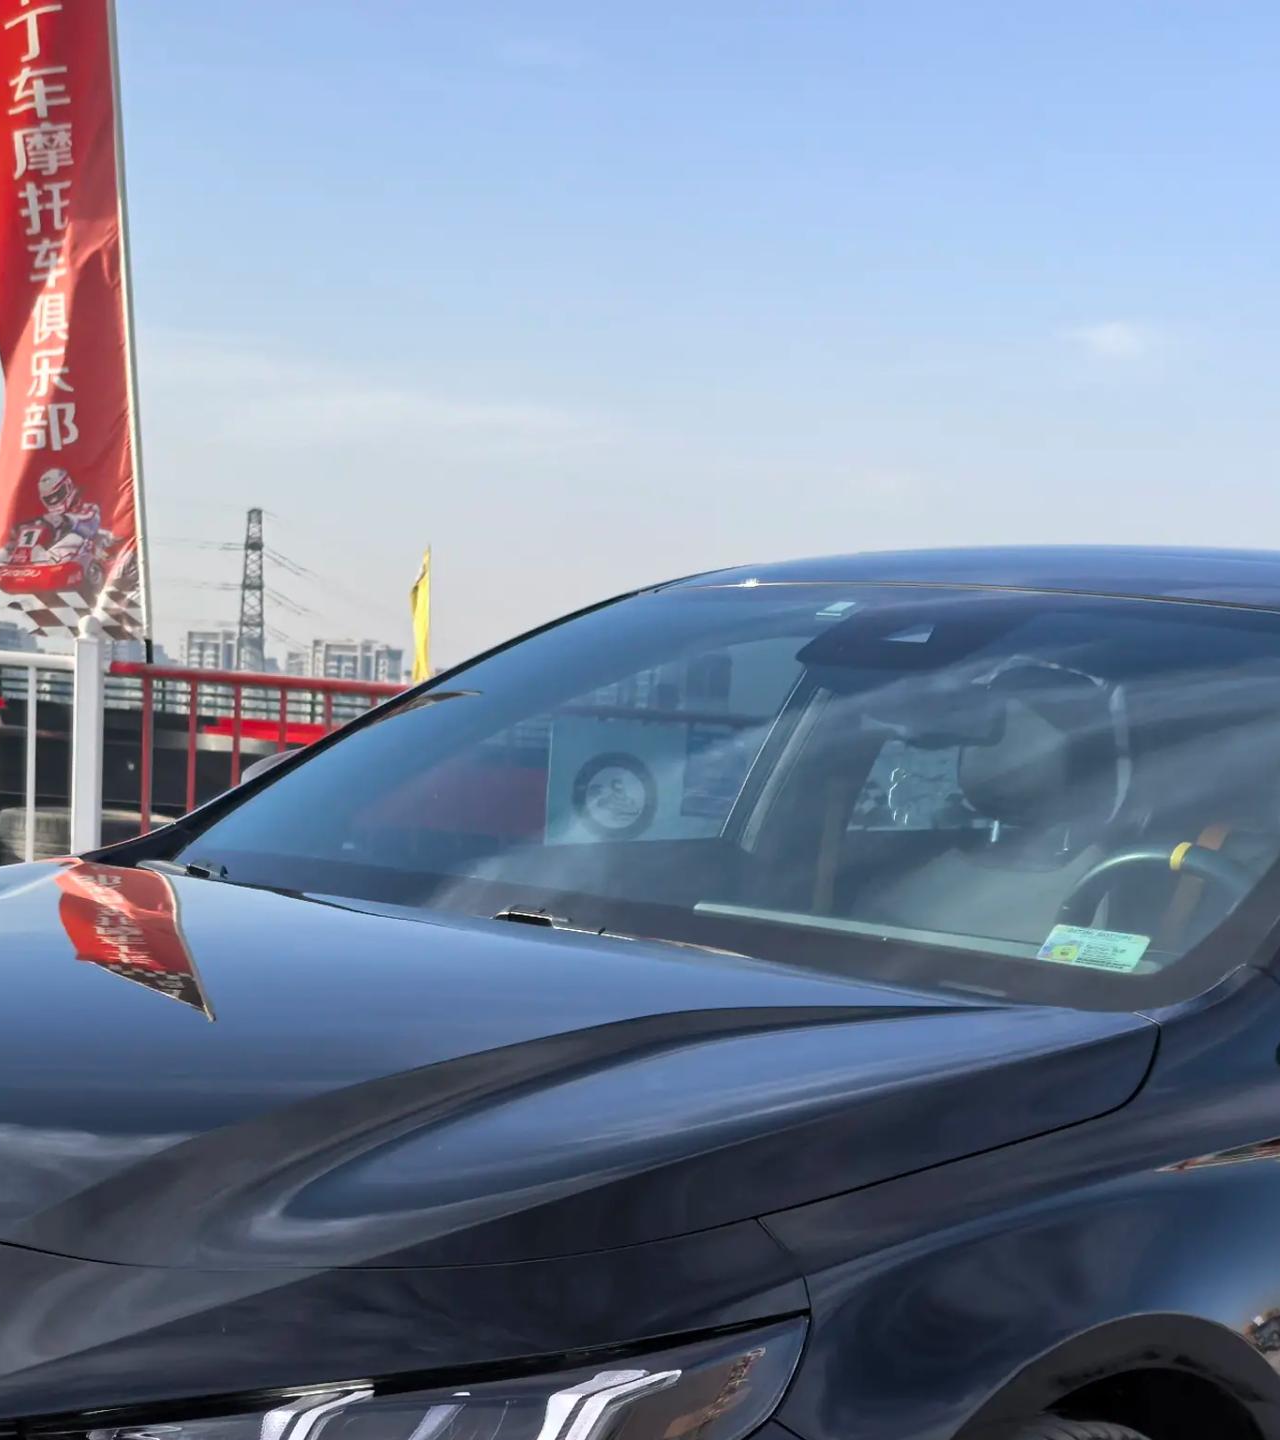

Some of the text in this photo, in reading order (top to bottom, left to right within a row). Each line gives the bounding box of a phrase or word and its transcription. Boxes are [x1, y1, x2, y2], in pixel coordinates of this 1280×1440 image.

[4, 0, 80, 453] 丁车摩托车俱乐部
[23, 530, 35, 546] 1
